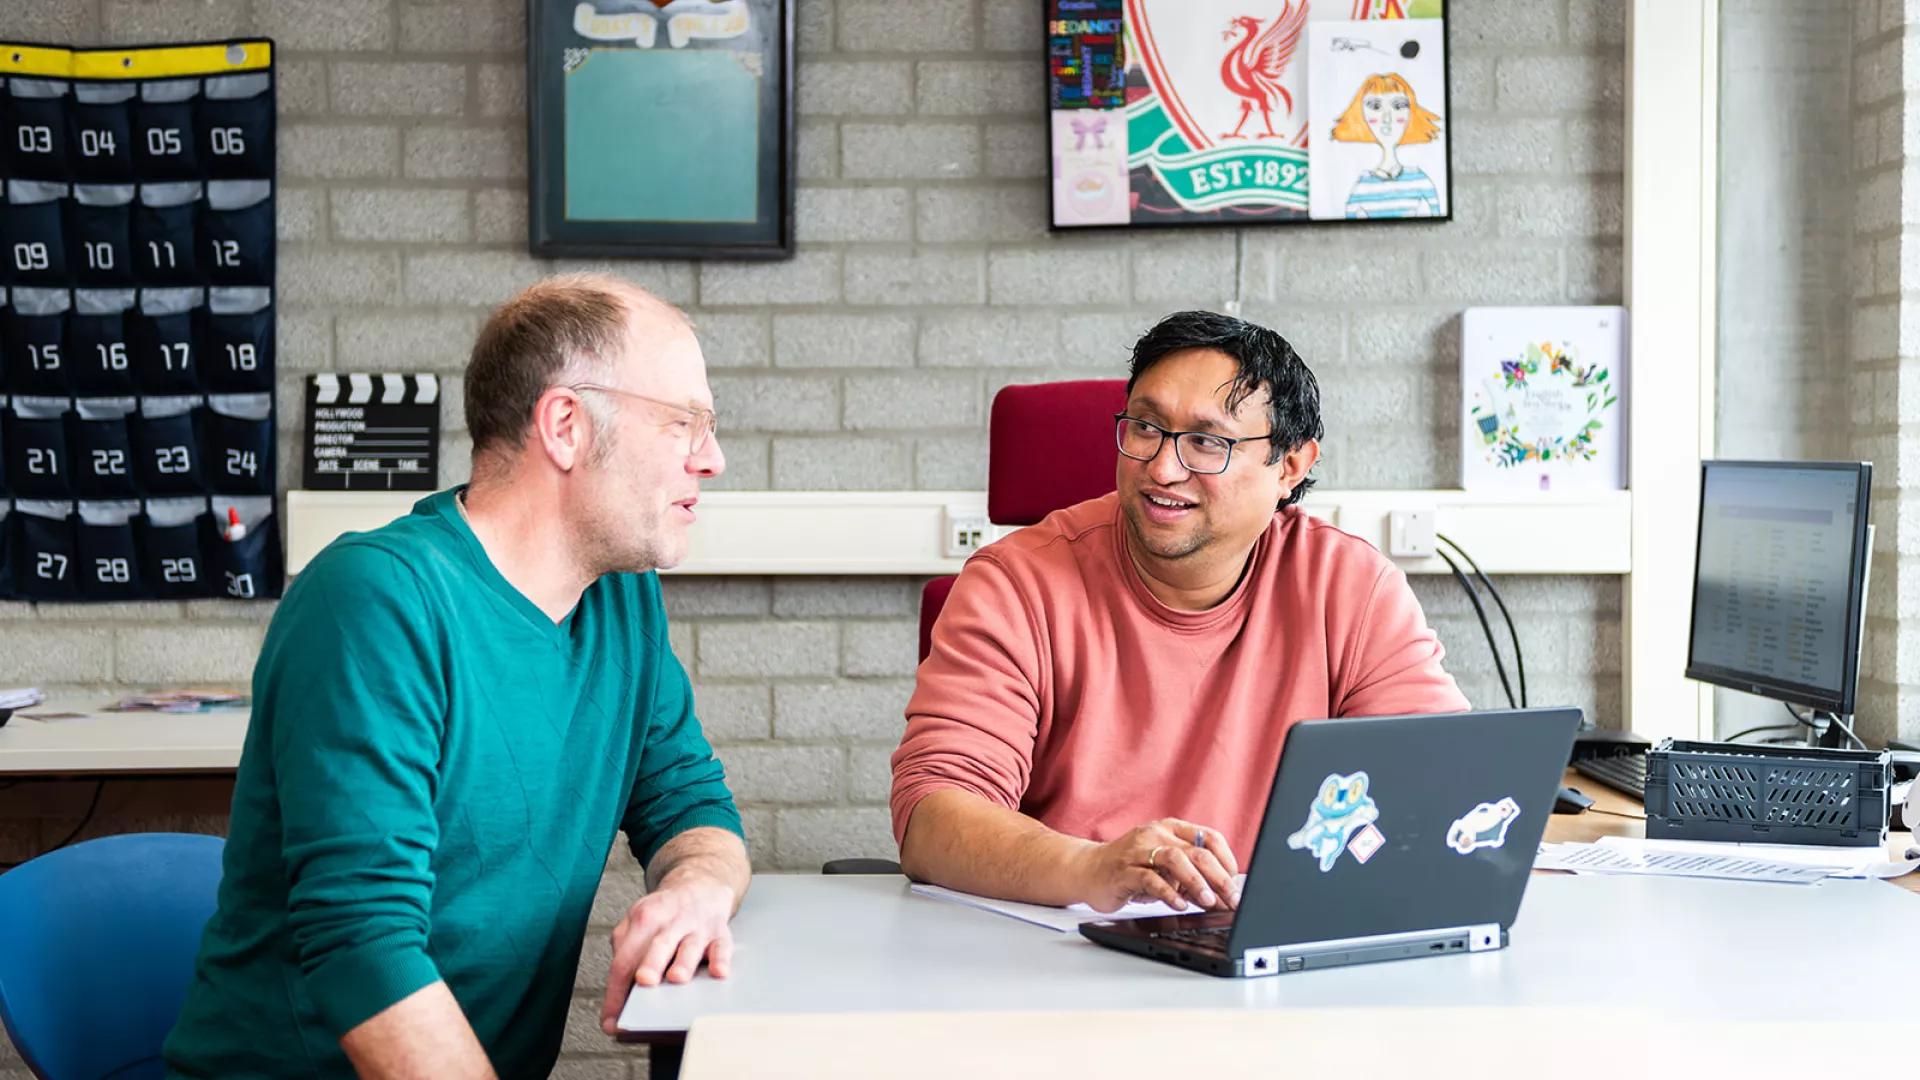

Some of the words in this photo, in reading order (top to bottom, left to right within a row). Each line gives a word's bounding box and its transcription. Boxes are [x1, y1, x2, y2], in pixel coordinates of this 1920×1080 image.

[583, 16, 649, 34] TODAY'S
[1049, 19, 1122, 35] BEDANKT
[1081, 45, 1093, 97] BEDANKT
[18, 125, 52, 153] 03
[81, 130, 116, 156] 04
[147, 128, 181, 155] 05
[211, 127, 245, 154] 06
[14, 242, 49, 270] 09
[85, 242, 114, 269] 10
[148, 241, 175, 268] 11
[212, 240, 240, 266] 12
[28, 344, 60, 370] 15
[97, 342, 128, 370] 16
[160, 342, 190, 370] 17
[226, 343, 257, 371] 18
[315, 407, 364, 419] HOLLYWOOD
[314, 434, 354, 445] DIRECTOR
[315, 421, 366, 432] PRODUCTION
[27, 448, 57, 474] 21
[92, 449, 126, 475] 22
[155, 445, 190, 473] 23
[227, 449, 257, 477] 24
[314, 447, 347, 459] CAMERA
[318, 459, 339, 471] DATE
[353, 459, 379, 471] SCENE
[398, 459, 418, 471] TAKE
[37, 552, 67, 580] 27
[95, 558, 129, 583] 28
[162, 557, 197, 582] 29
[225, 571, 255, 598] 30
